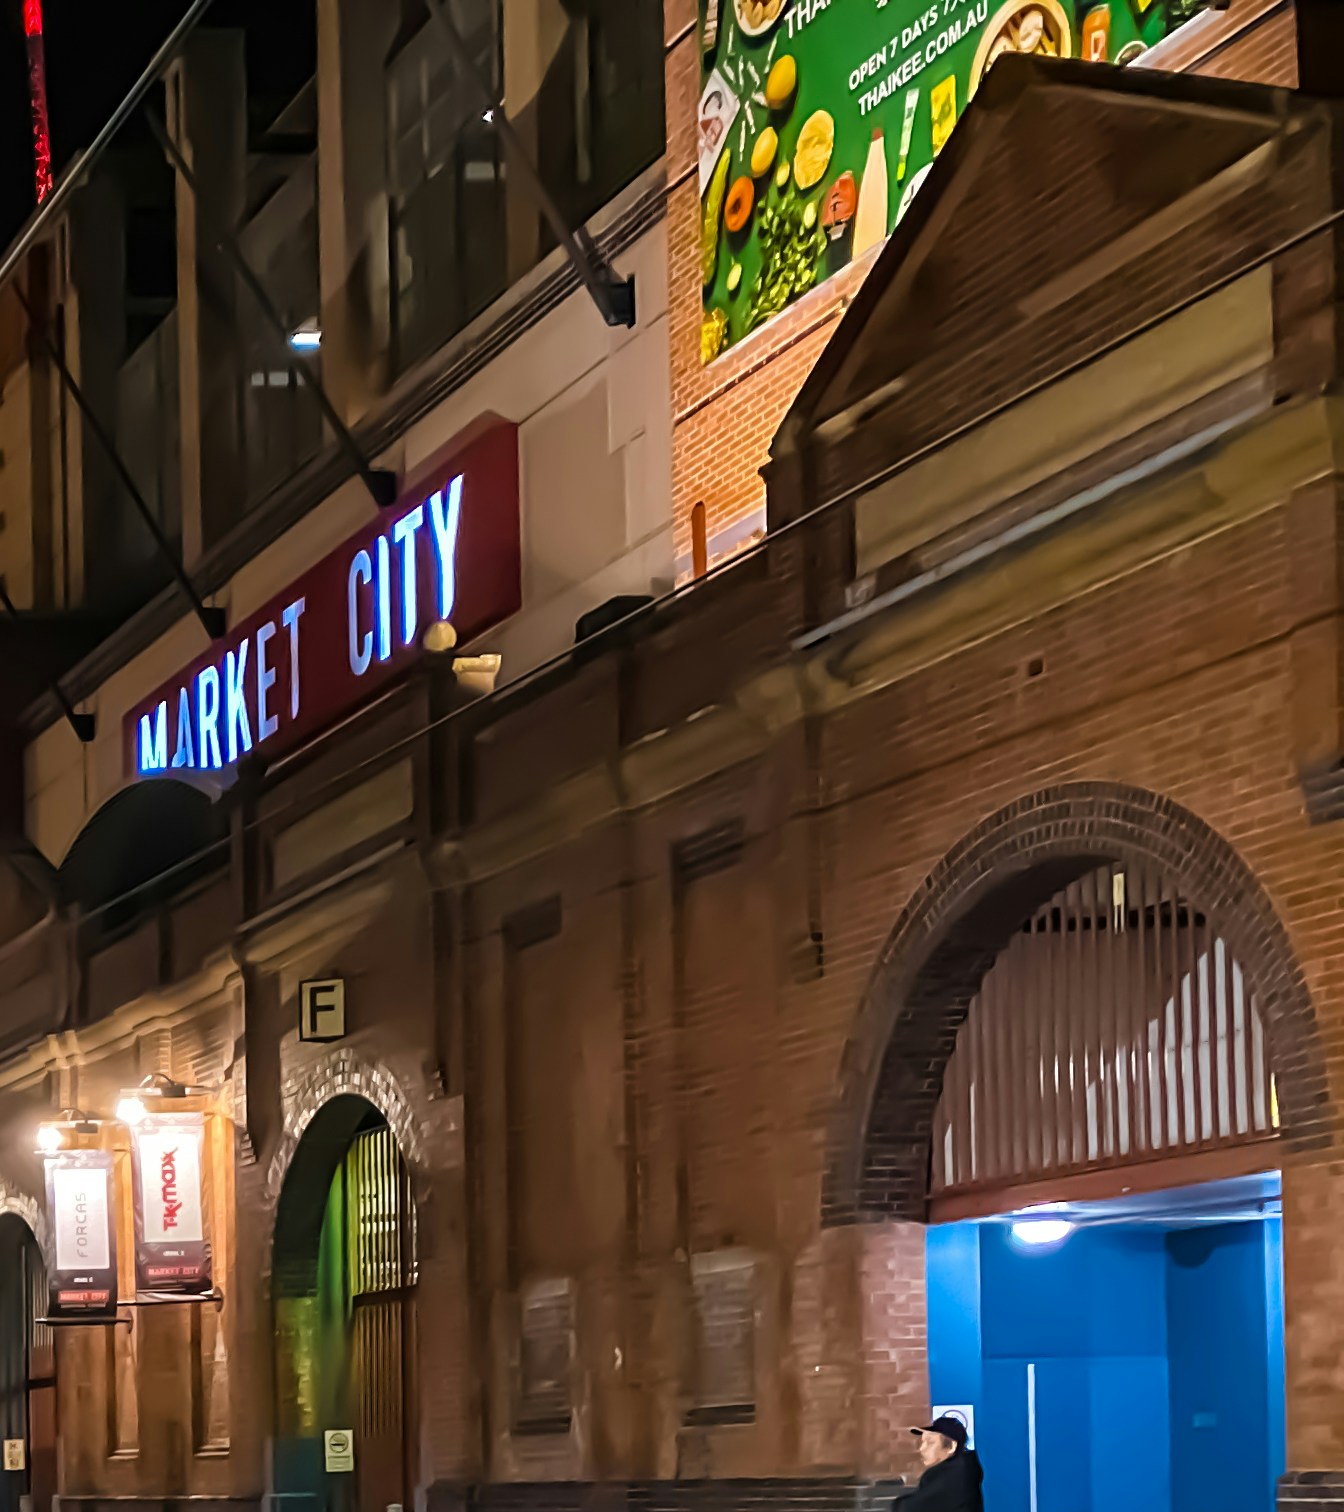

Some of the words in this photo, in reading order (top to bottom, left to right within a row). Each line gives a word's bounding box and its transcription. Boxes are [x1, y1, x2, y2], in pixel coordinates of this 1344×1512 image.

[784, 0, 831, 38] THA
[849, 46, 886, 90] OPEN
[890, 37, 898, 58] 7
[902, 5, 938, 48] DAYS
[858, 0, 988, 115] THAIKEE.COM.AU
[136, 596, 306, 774] MARKET
[348, 472, 465, 677] CITY
[309, 985, 339, 1033] F
